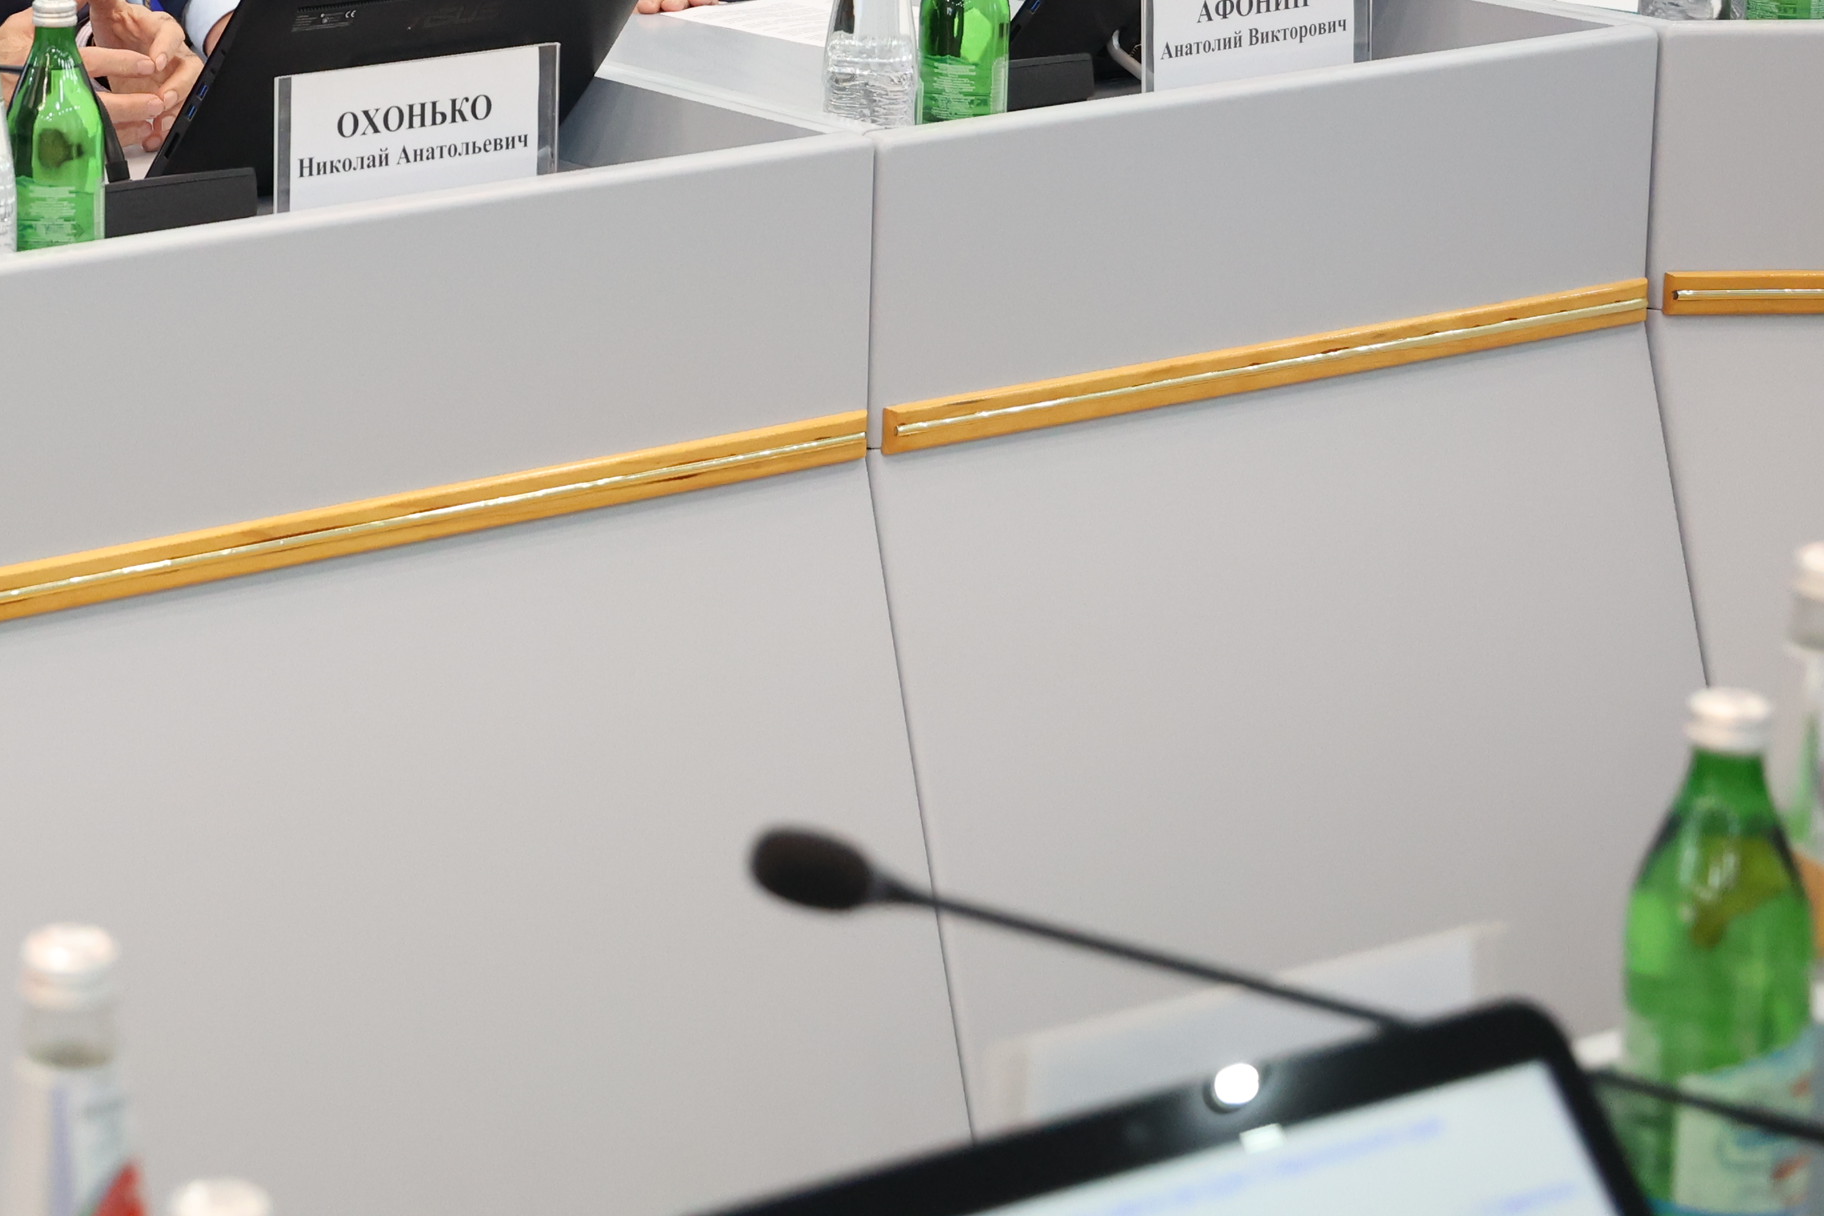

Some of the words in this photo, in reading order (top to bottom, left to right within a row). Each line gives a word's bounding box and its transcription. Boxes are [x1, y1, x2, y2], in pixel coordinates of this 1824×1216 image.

[1160, 30, 1244, 61] Анатолий
[1248, 18, 1348, 47] Викторович
[336, 94, 493, 139] ОХОНЬКО
[297, 148, 390, 179] Николай
[395, 133, 529, 166] Анатольевич
